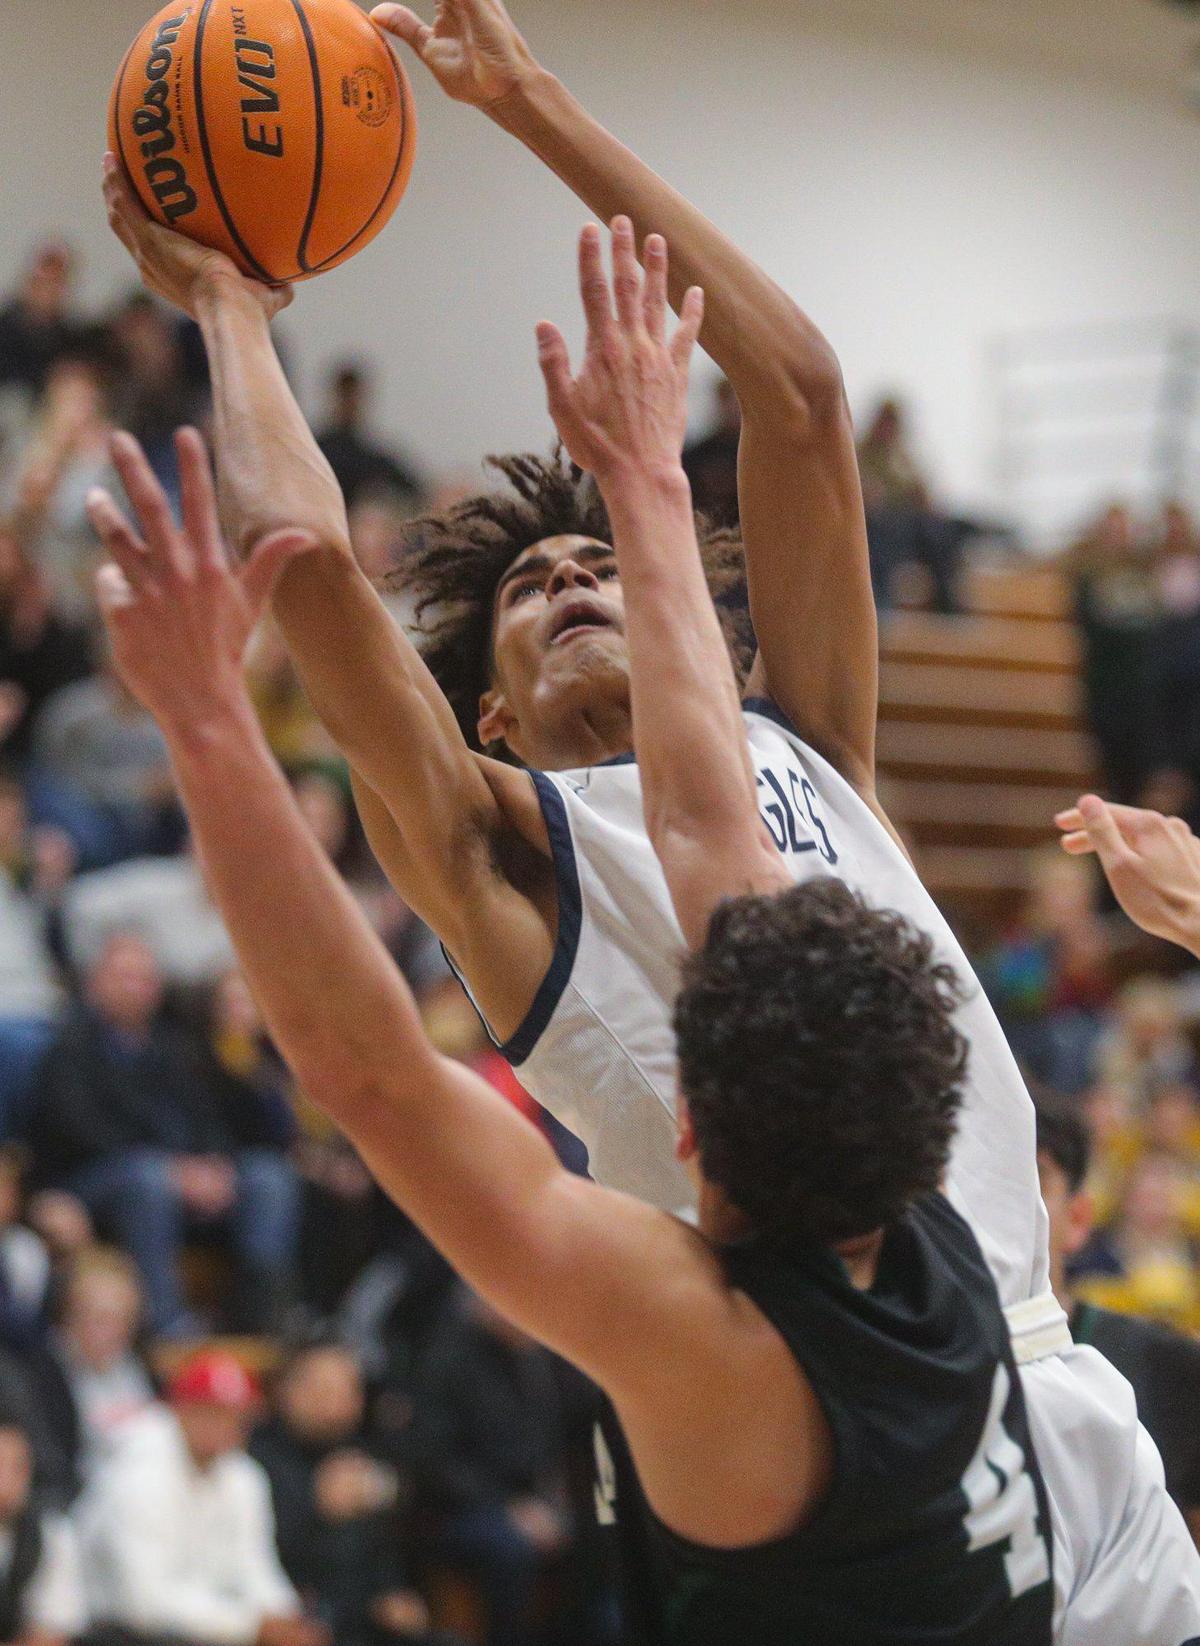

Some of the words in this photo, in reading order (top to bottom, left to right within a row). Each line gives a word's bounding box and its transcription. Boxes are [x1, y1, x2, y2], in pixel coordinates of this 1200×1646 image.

[230, 6, 248, 36] NXT
[132, 11, 198, 225] Wilson
[234, 37, 285, 159] EVO
